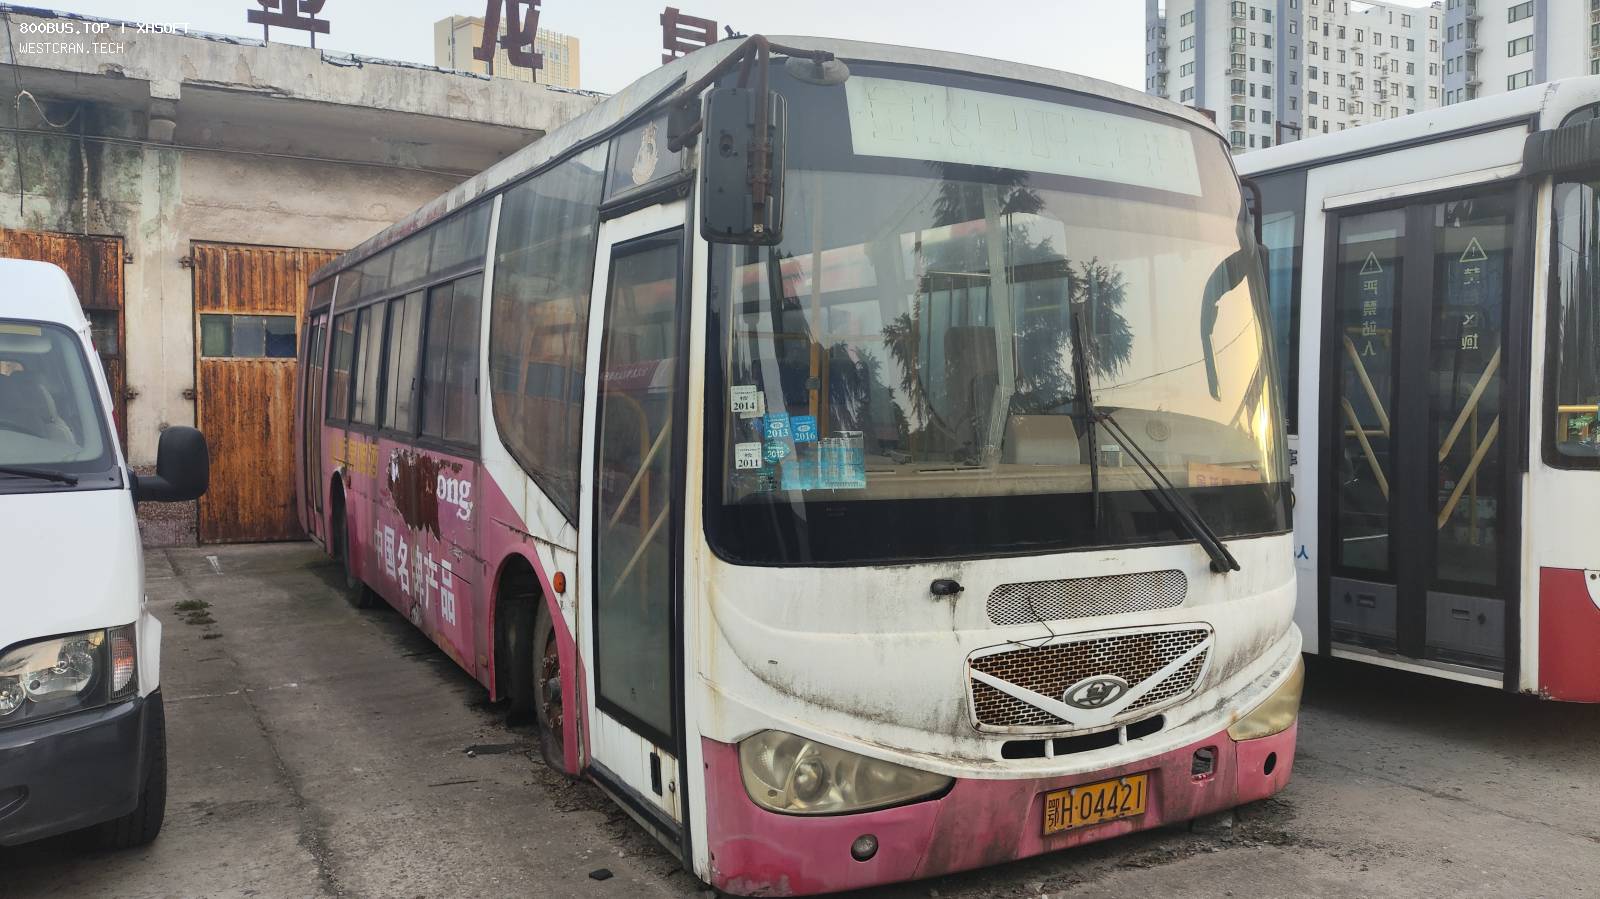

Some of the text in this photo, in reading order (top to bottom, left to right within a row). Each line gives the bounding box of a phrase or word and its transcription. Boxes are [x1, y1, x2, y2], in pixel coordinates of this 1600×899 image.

[733, 401, 755, 411] 2014
[767, 429, 789, 438] 2013
[794, 432, 816, 441] 2016
[767, 450, 785, 458] 2012
[738, 459, 759, 468] 2011
[436, 474, 474, 521] ong
